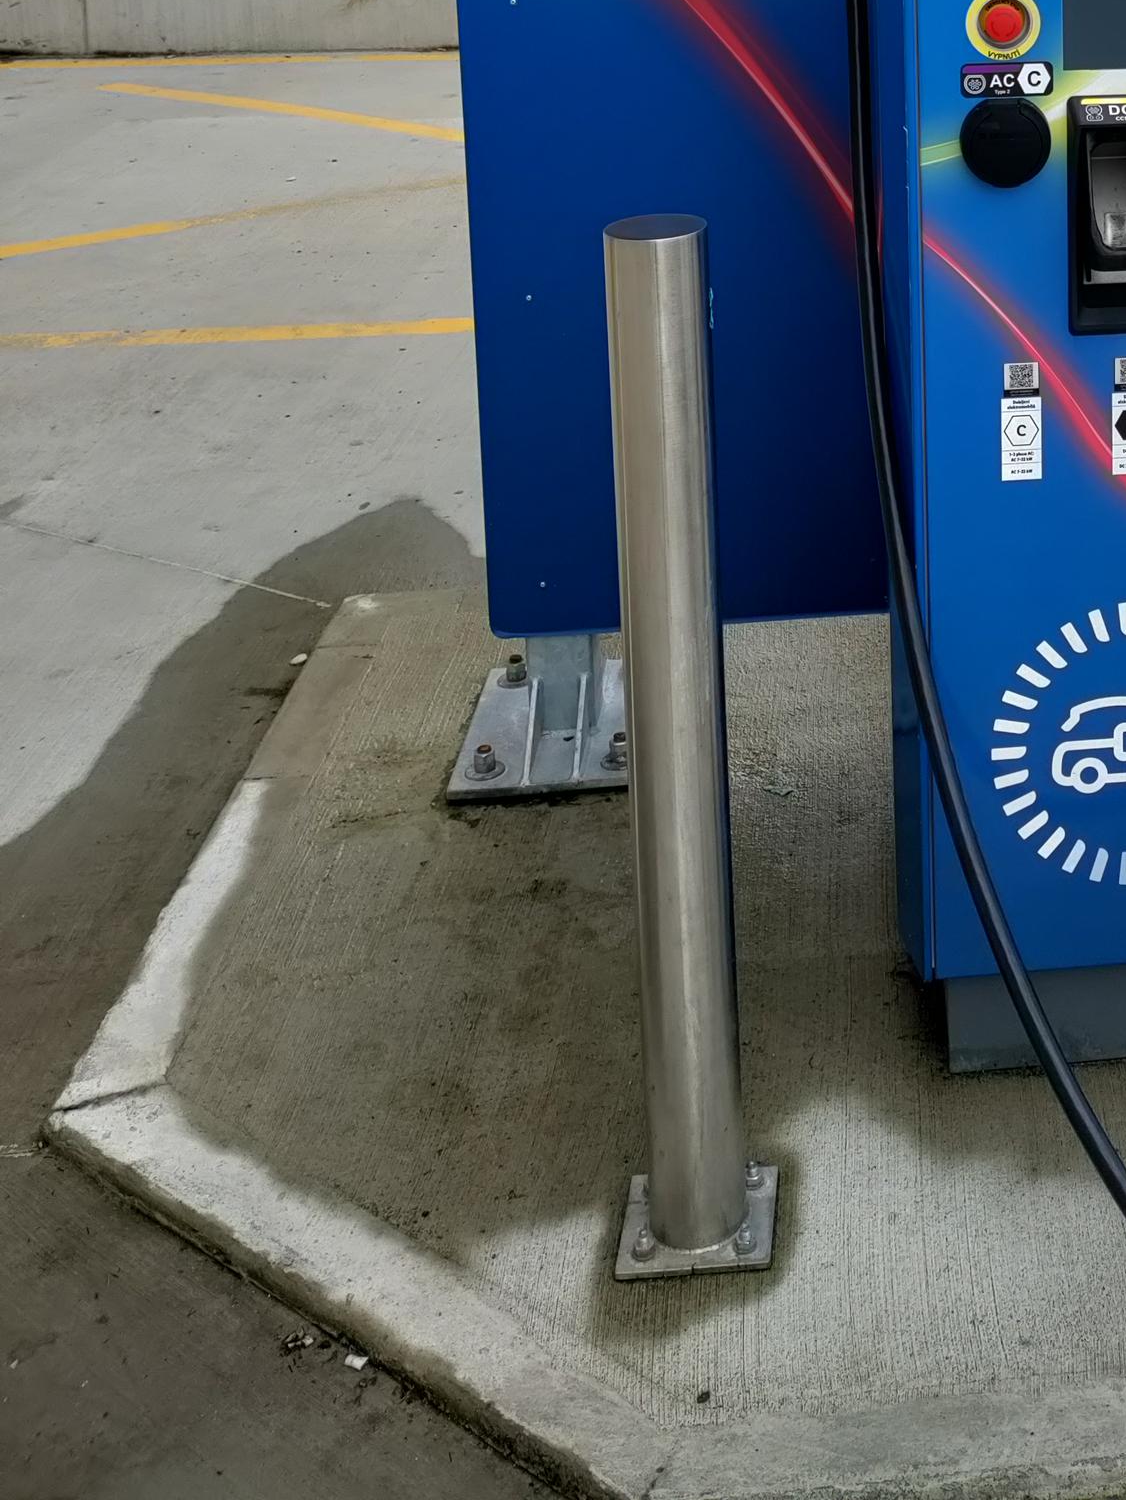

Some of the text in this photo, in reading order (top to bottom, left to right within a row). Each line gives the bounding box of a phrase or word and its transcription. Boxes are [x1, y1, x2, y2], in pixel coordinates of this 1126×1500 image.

[990, 70, 1042, 88] AC C
[1016, 424, 1027, 437] C
